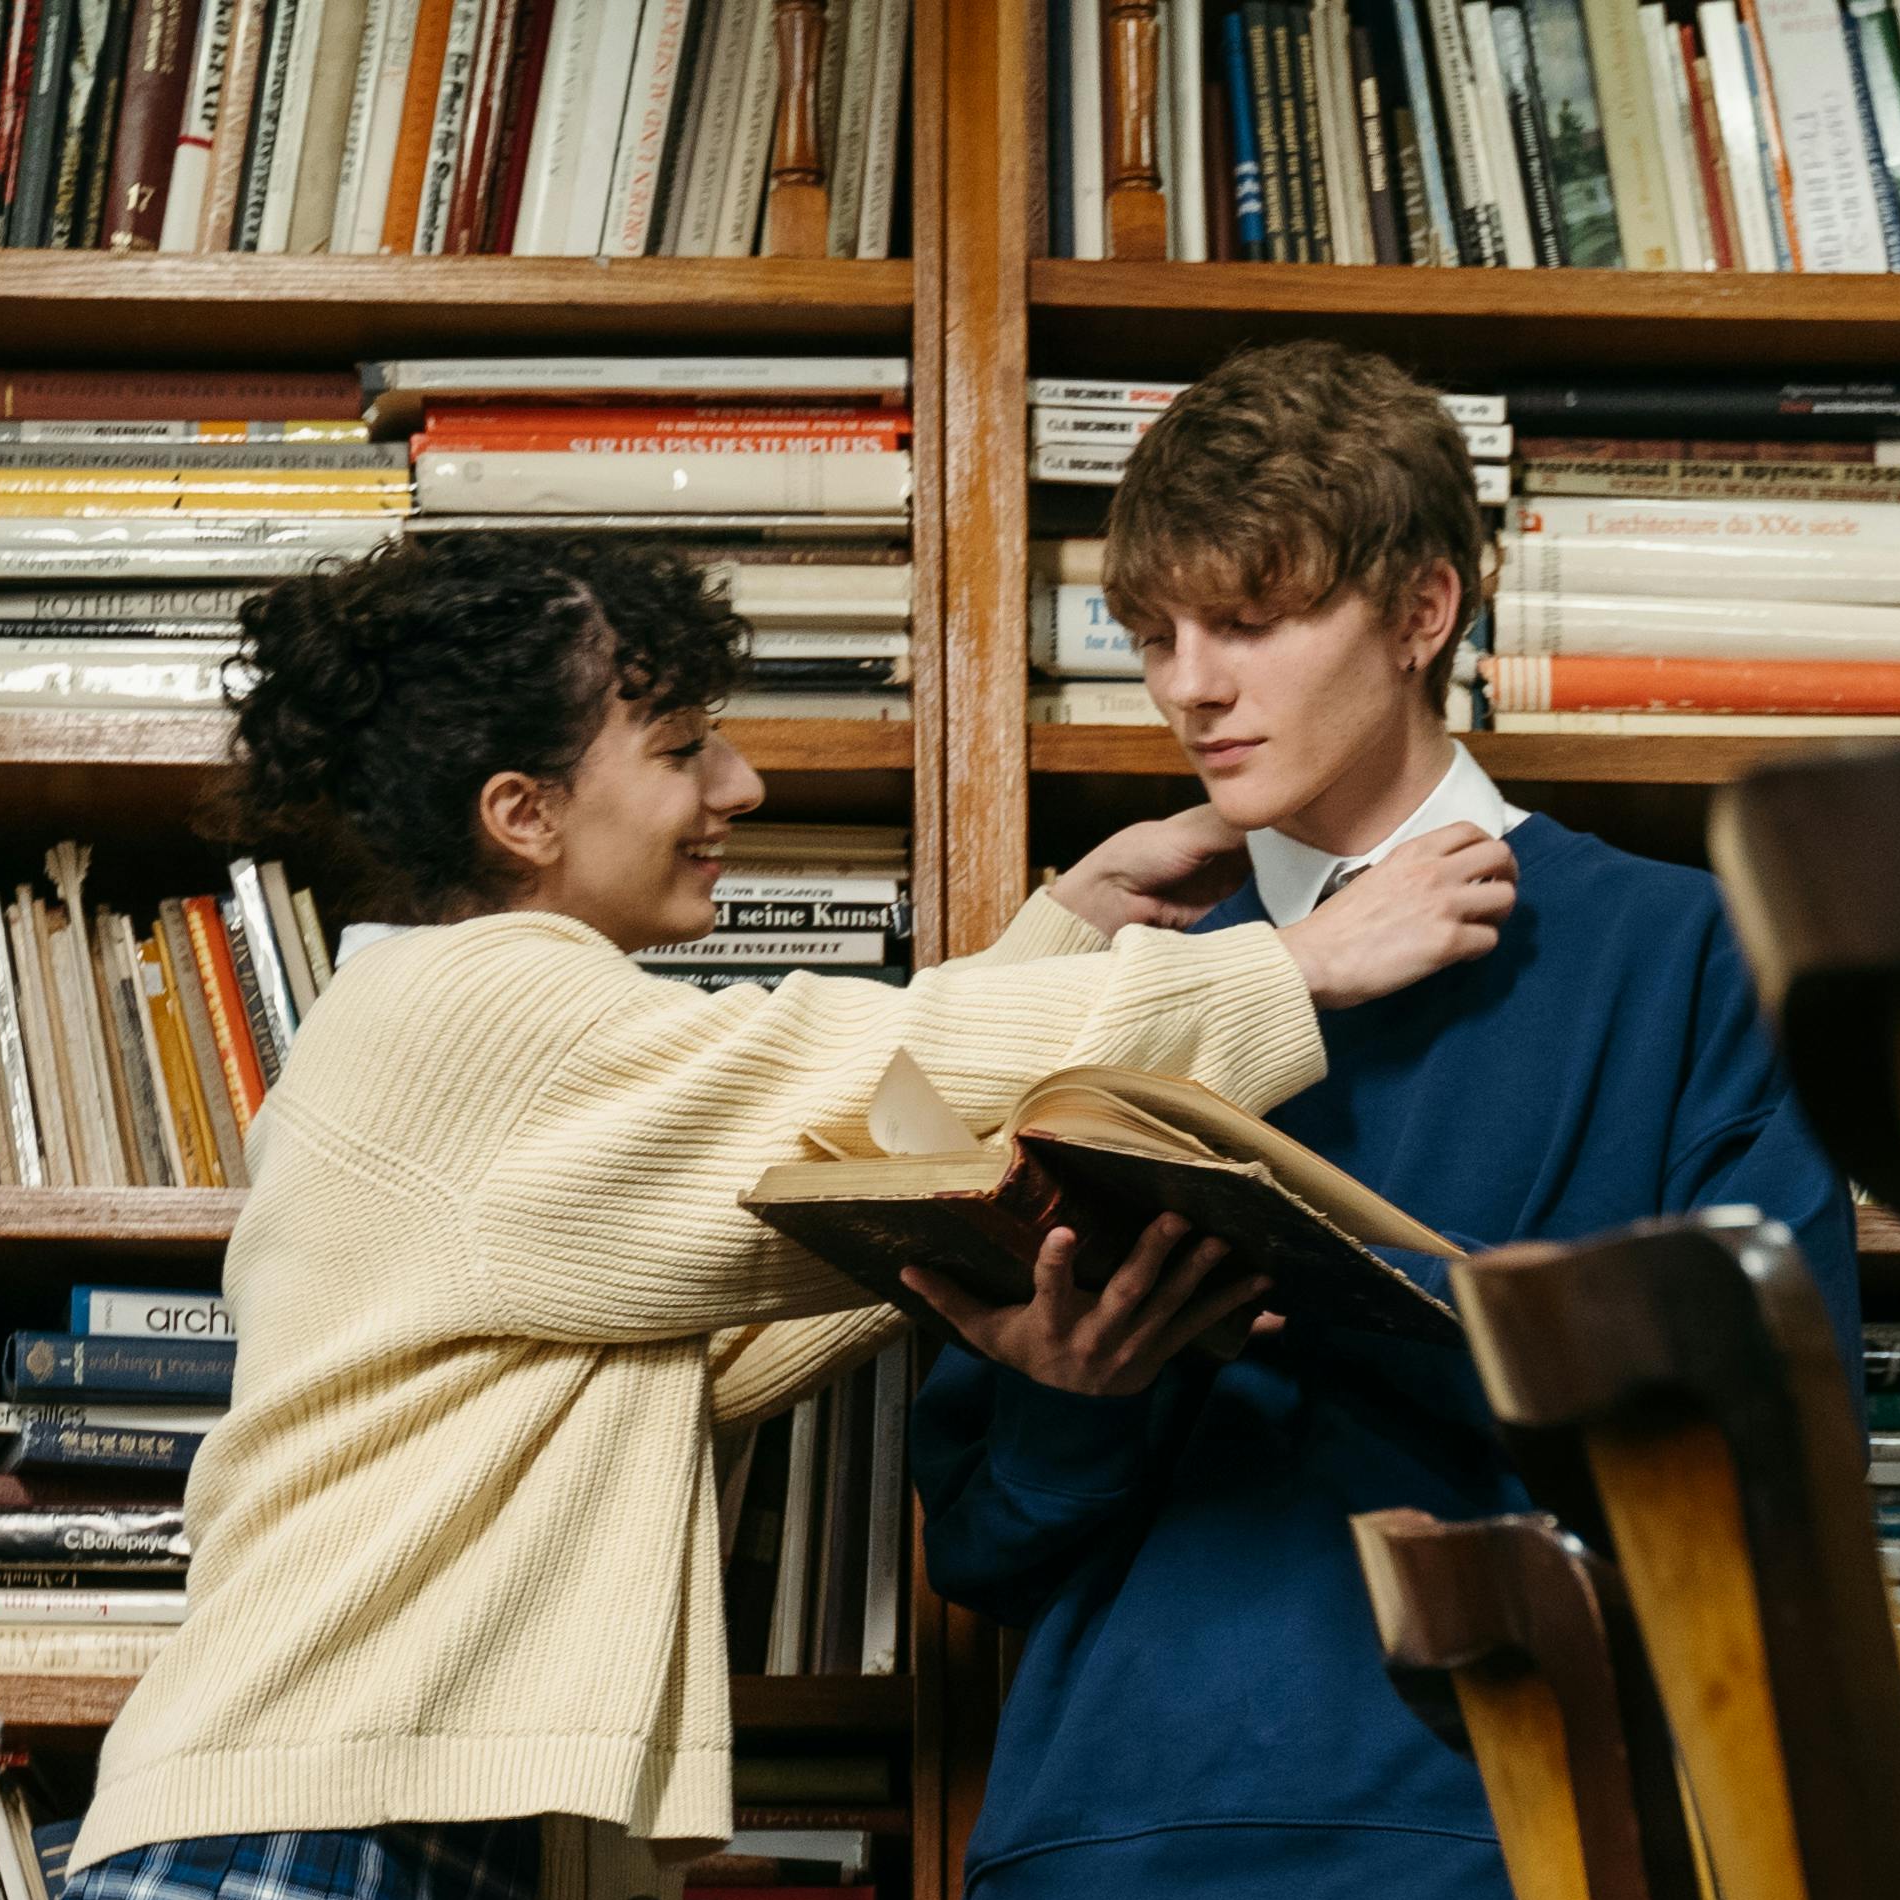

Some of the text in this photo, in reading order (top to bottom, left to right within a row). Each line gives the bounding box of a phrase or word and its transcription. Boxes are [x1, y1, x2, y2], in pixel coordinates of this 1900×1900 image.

[737, 903, 806, 926] seine
[811, 902, 892, 927] Kunst
[145, 1301, 236, 1335] arch
